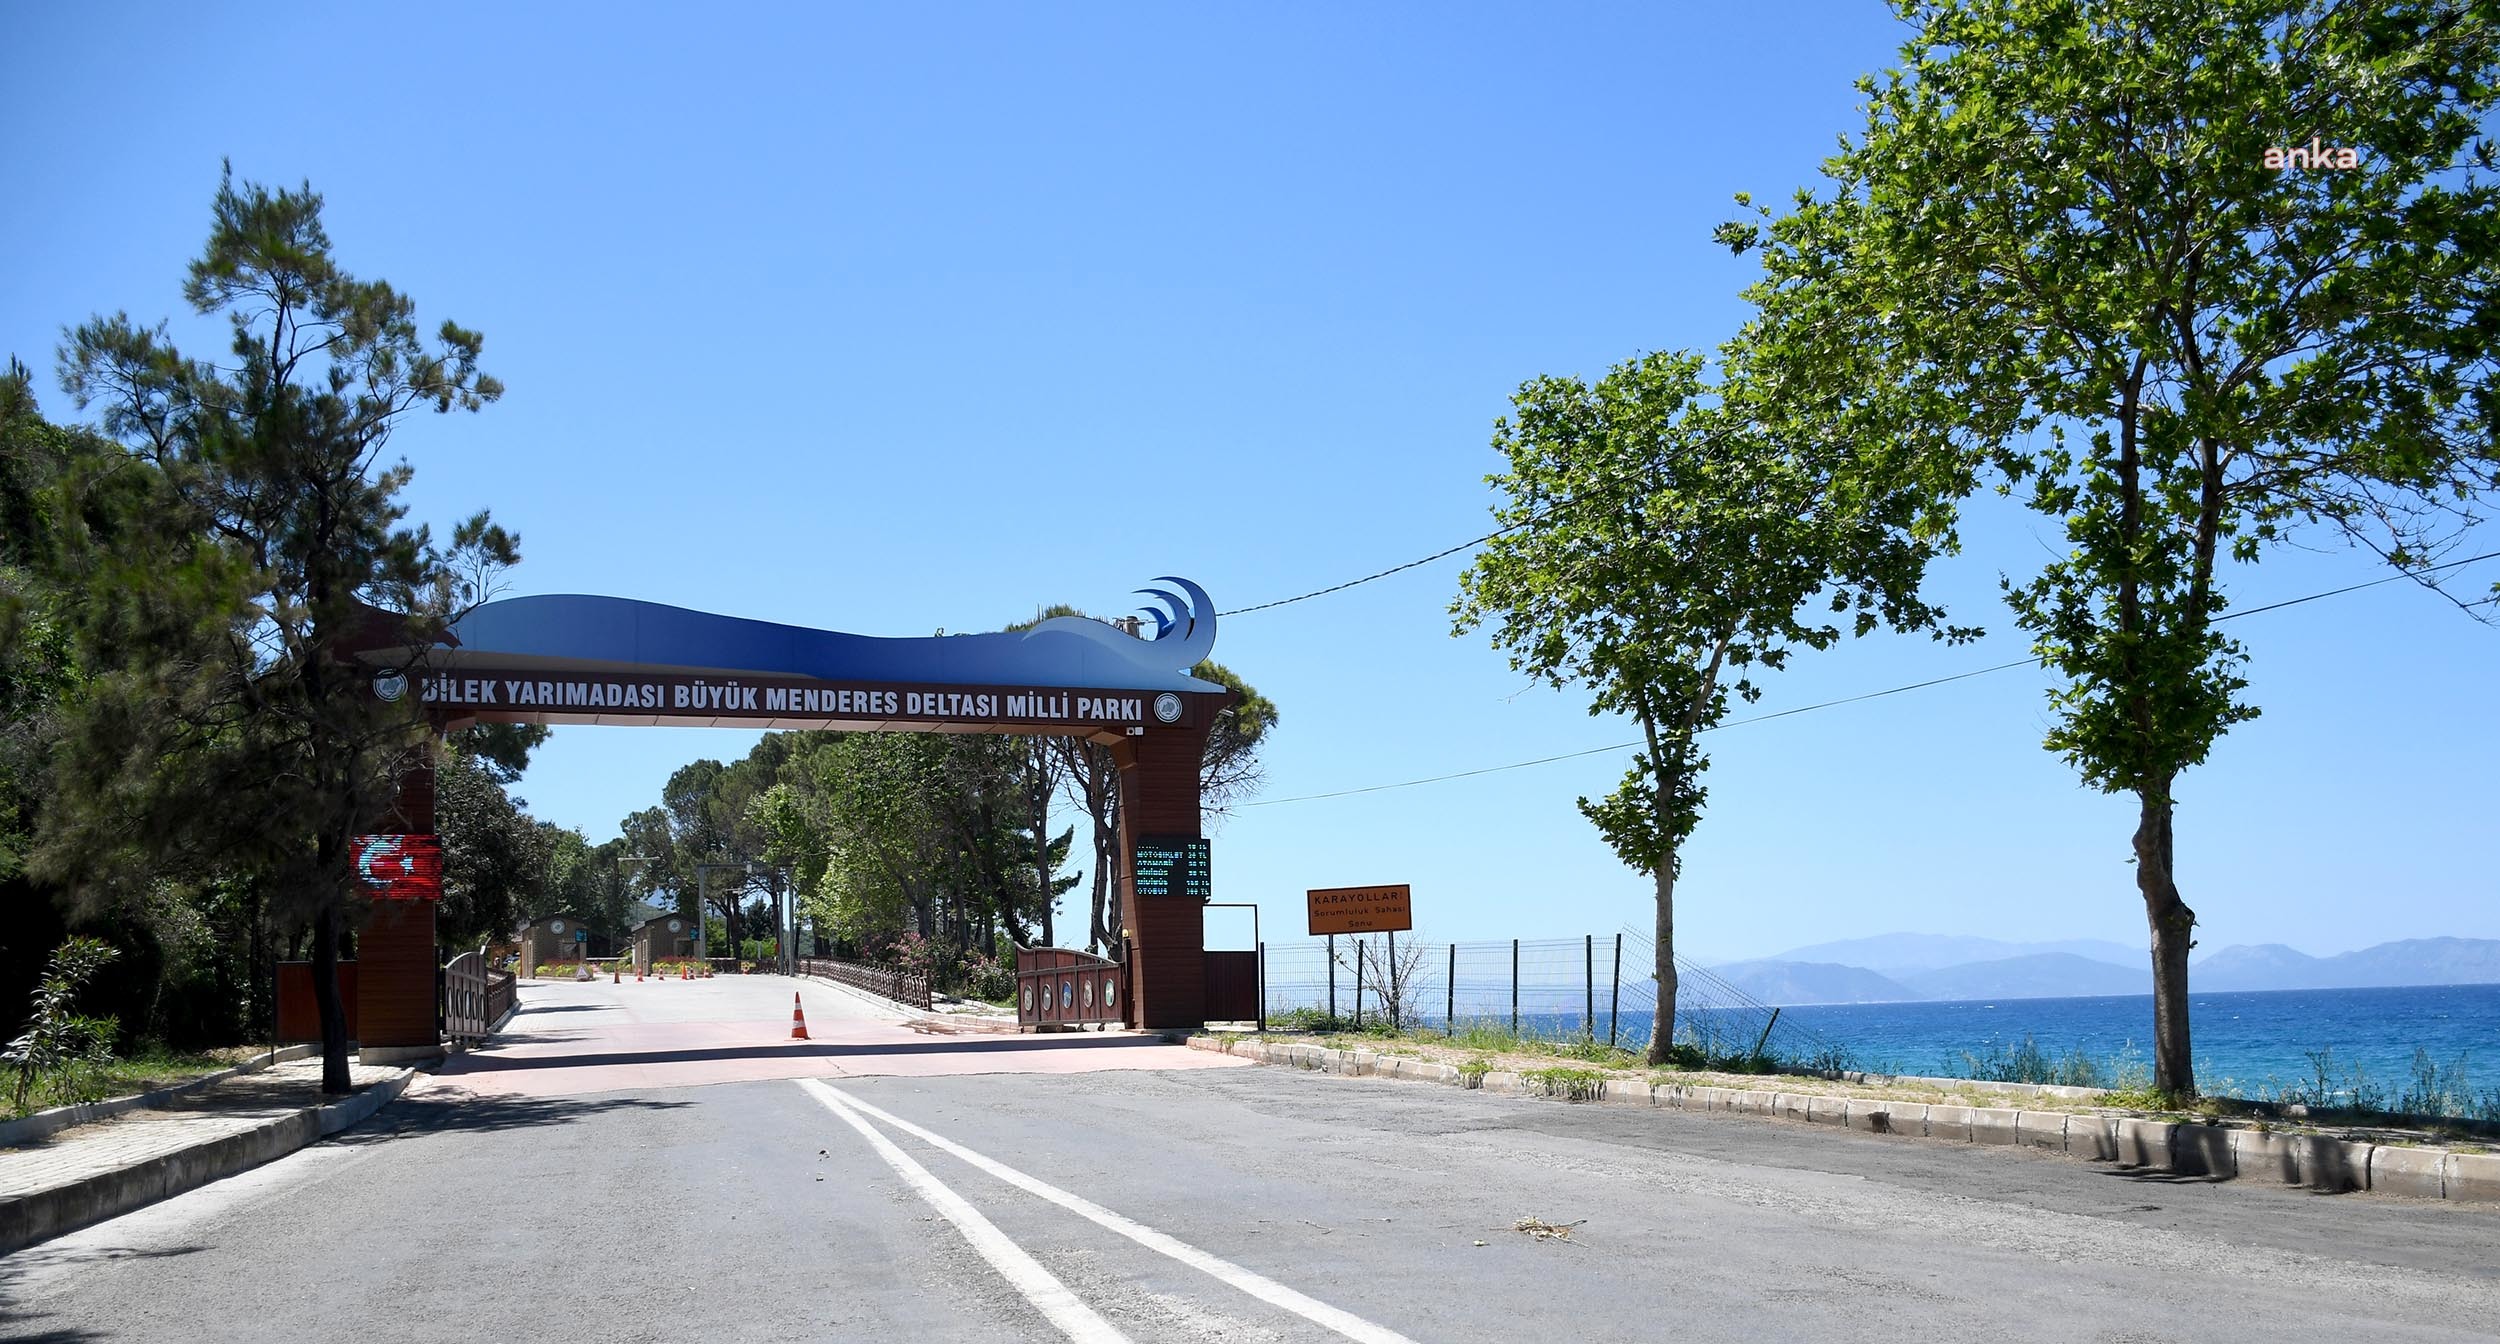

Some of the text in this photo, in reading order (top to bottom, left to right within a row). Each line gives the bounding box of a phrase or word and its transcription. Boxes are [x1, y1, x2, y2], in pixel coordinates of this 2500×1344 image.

[505, 680, 664, 708] YARIMADASI
[674, 680, 758, 710] BÜYÜK
[766, 688, 898, 714] MENDERES
[907, 692, 998, 717] DELTASI
[1007, 691, 1069, 718] MİLLİ
[1077, 697, 1142, 721] PARKI
[1313, 907, 1369, 918] Sorumluluk
[1348, 920, 1373, 928] Sonu
